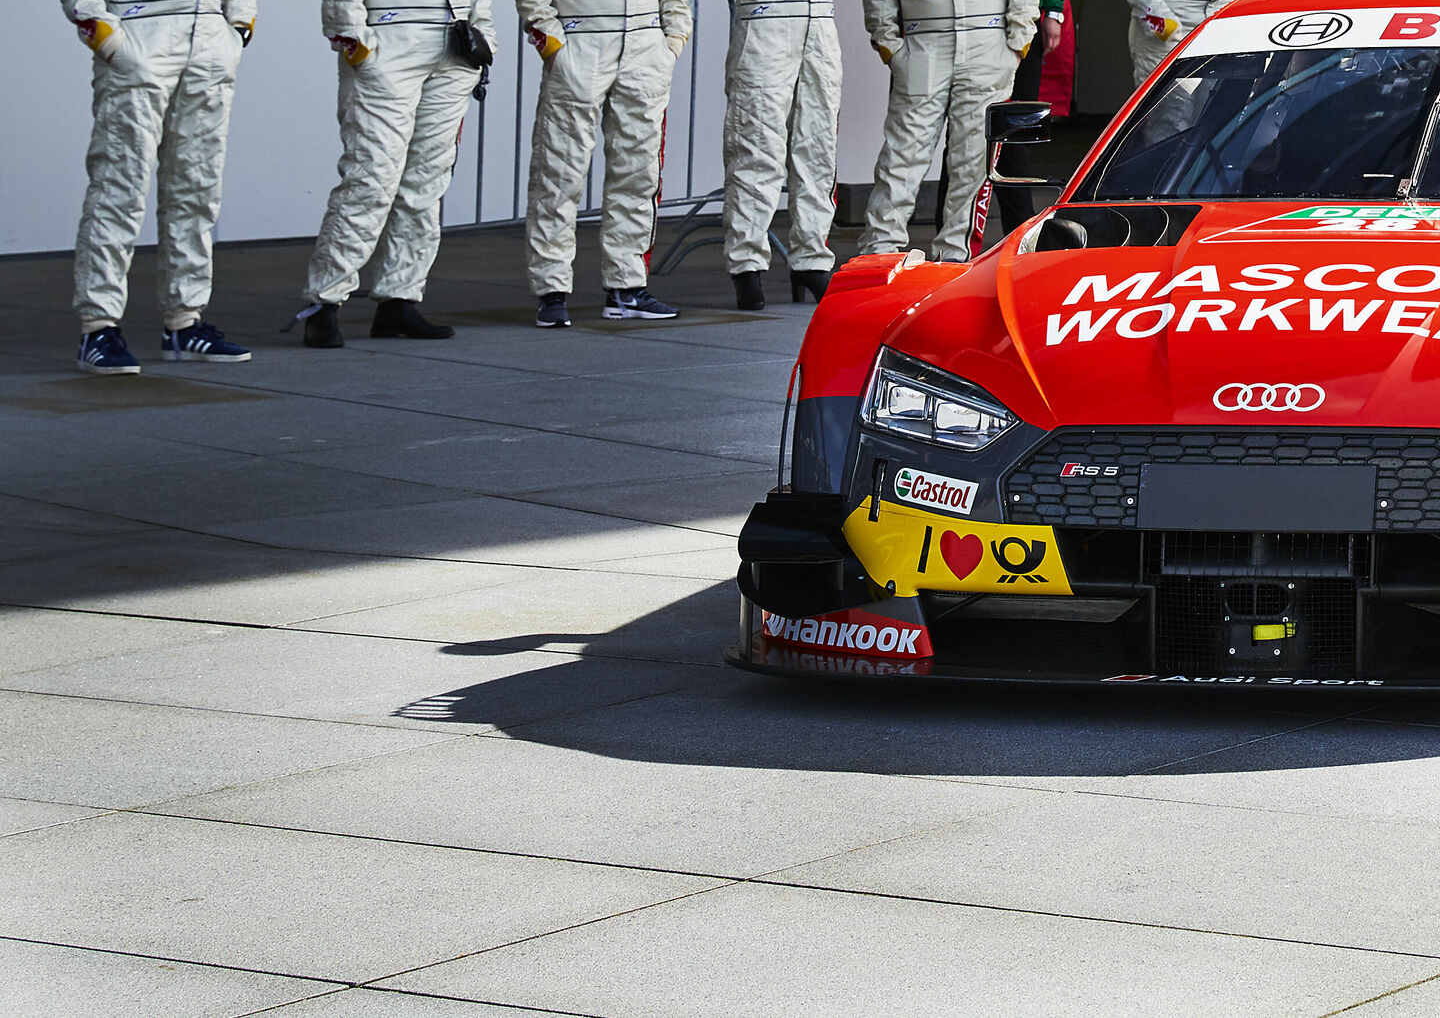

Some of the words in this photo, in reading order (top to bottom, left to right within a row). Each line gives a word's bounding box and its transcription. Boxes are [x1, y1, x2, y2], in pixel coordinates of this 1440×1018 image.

[1307, 218, 1420, 231] 28
[1069, 466, 1101, 476] RS
[1103, 466, 1119, 476] 5
[911, 474, 971, 510] Castrol
[1159, 675, 1256, 683] Audi
[1267, 677, 1384, 686] Sport
